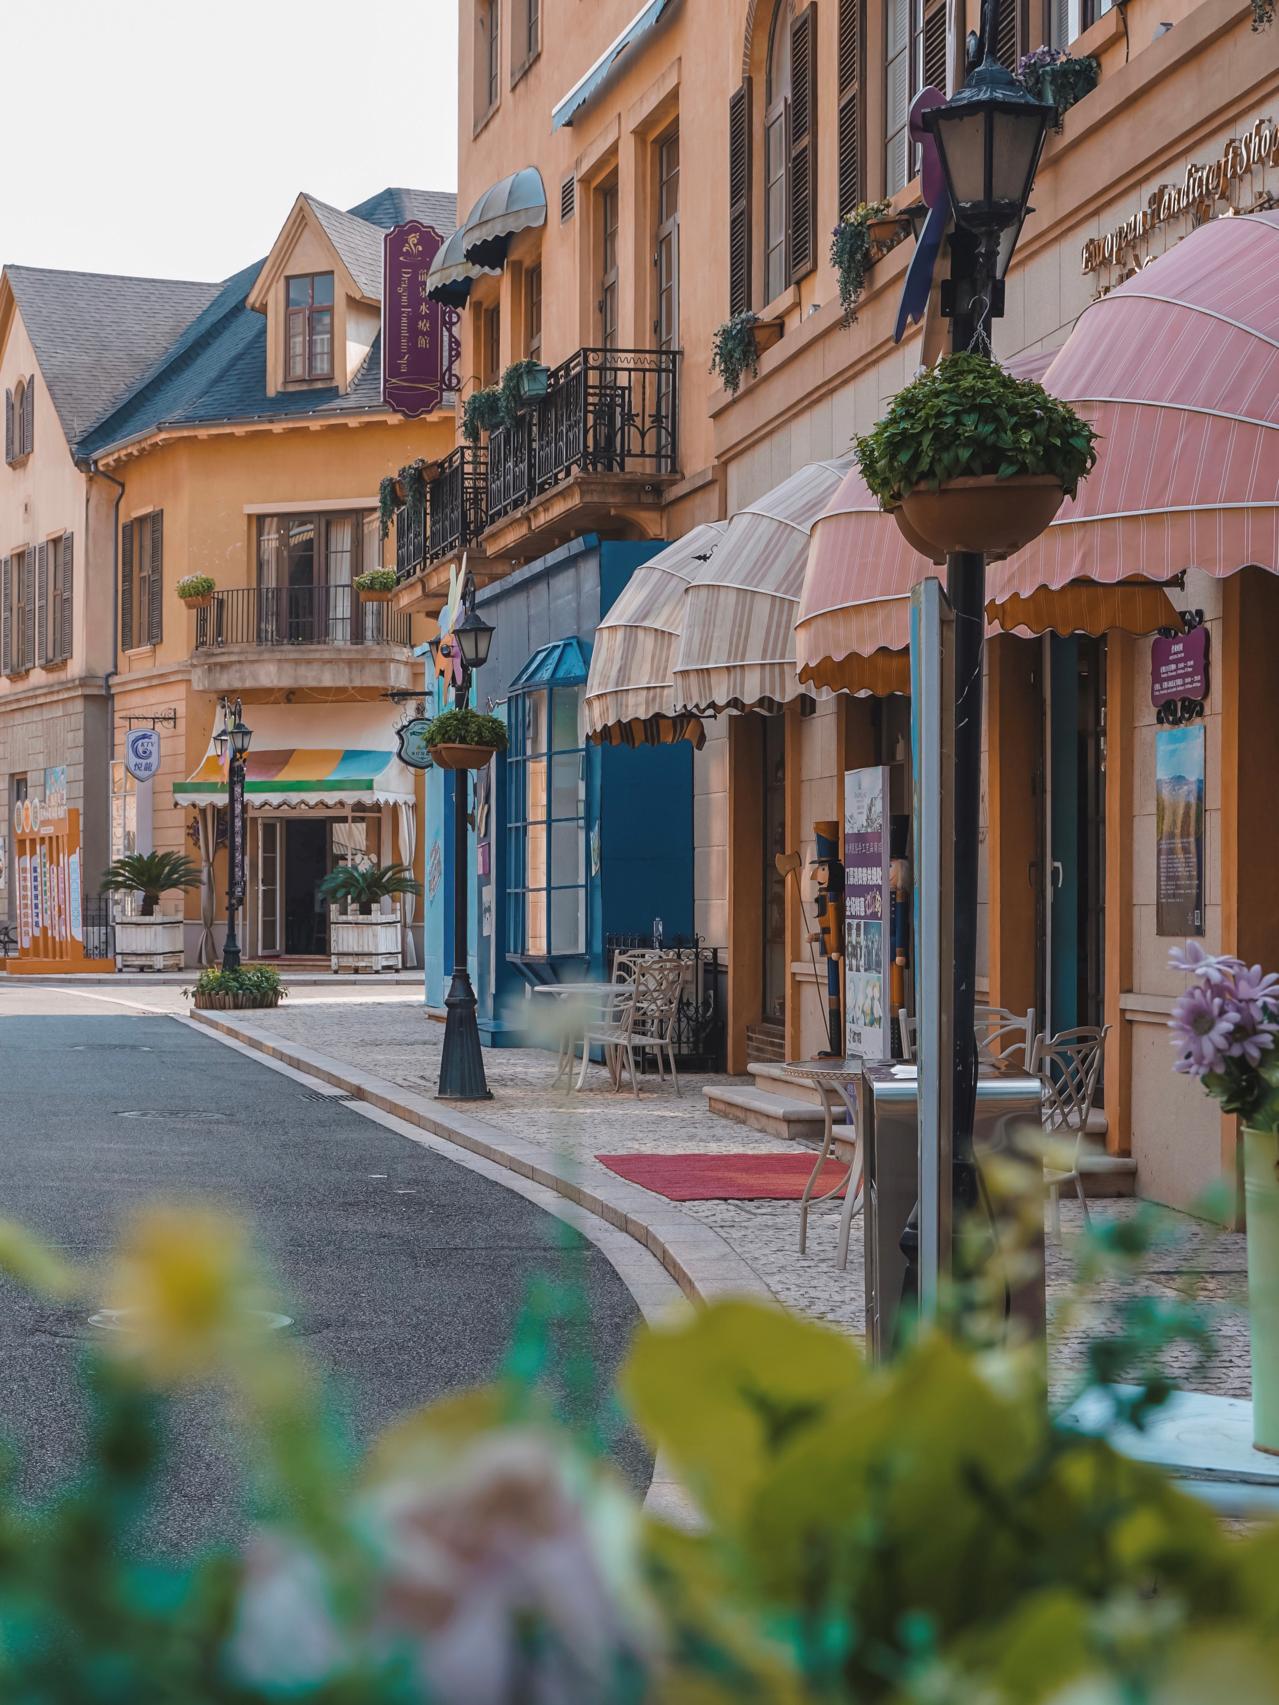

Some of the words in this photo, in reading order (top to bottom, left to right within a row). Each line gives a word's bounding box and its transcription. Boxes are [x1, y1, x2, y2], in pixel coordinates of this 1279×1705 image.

[1082, 210, 1147, 275] European
[1149, 139, 1237, 230] Handicraft
[1237, 118, 1279, 174] Shop
[397, 268, 413, 305] Dragon
[401, 308, 413, 353] Fountain
[397, 354, 411, 372] Spa
